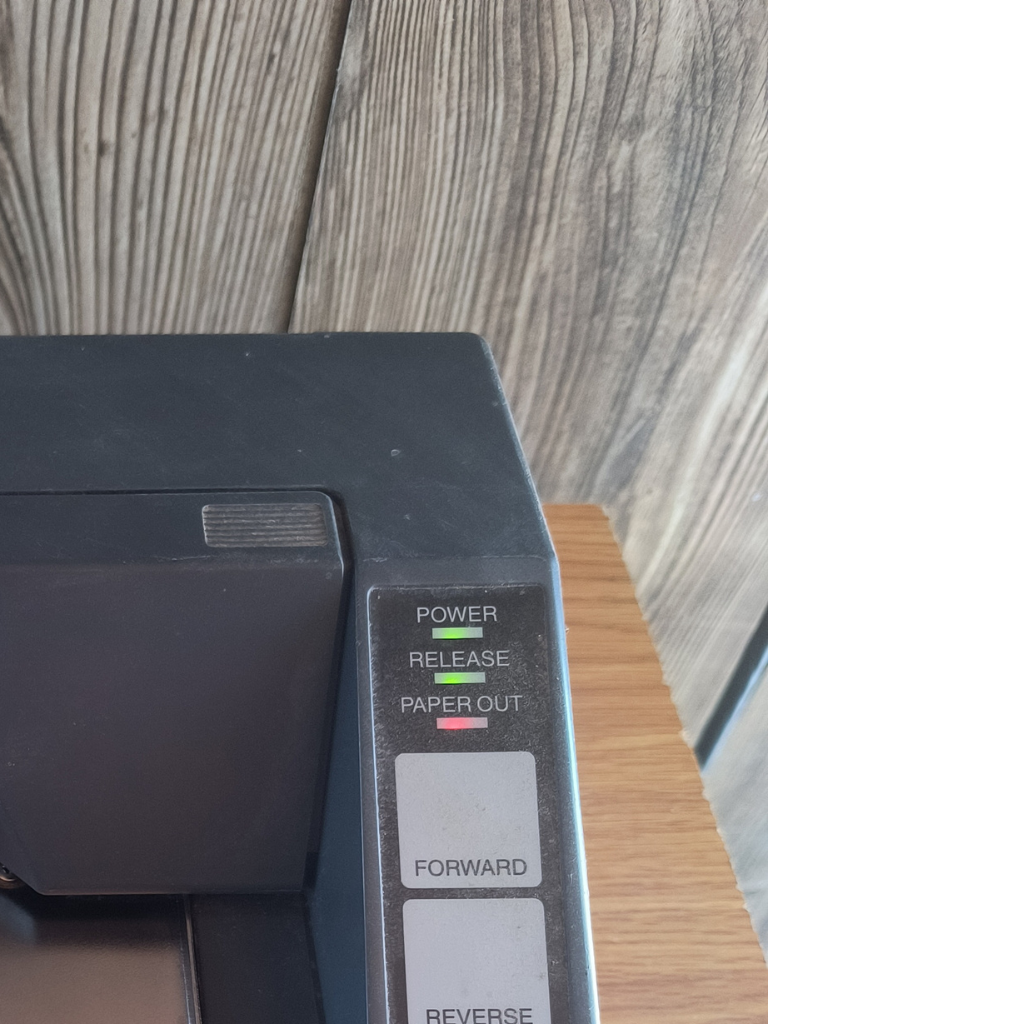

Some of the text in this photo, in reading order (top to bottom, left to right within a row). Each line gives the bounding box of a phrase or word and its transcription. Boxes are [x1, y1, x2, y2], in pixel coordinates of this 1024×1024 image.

[416, 605, 498, 623] POWER
[408, 650, 510, 668] RELEASE
[400, 695, 523, 713] PAPER OUT
[414, 859, 528, 877] FORWARD
